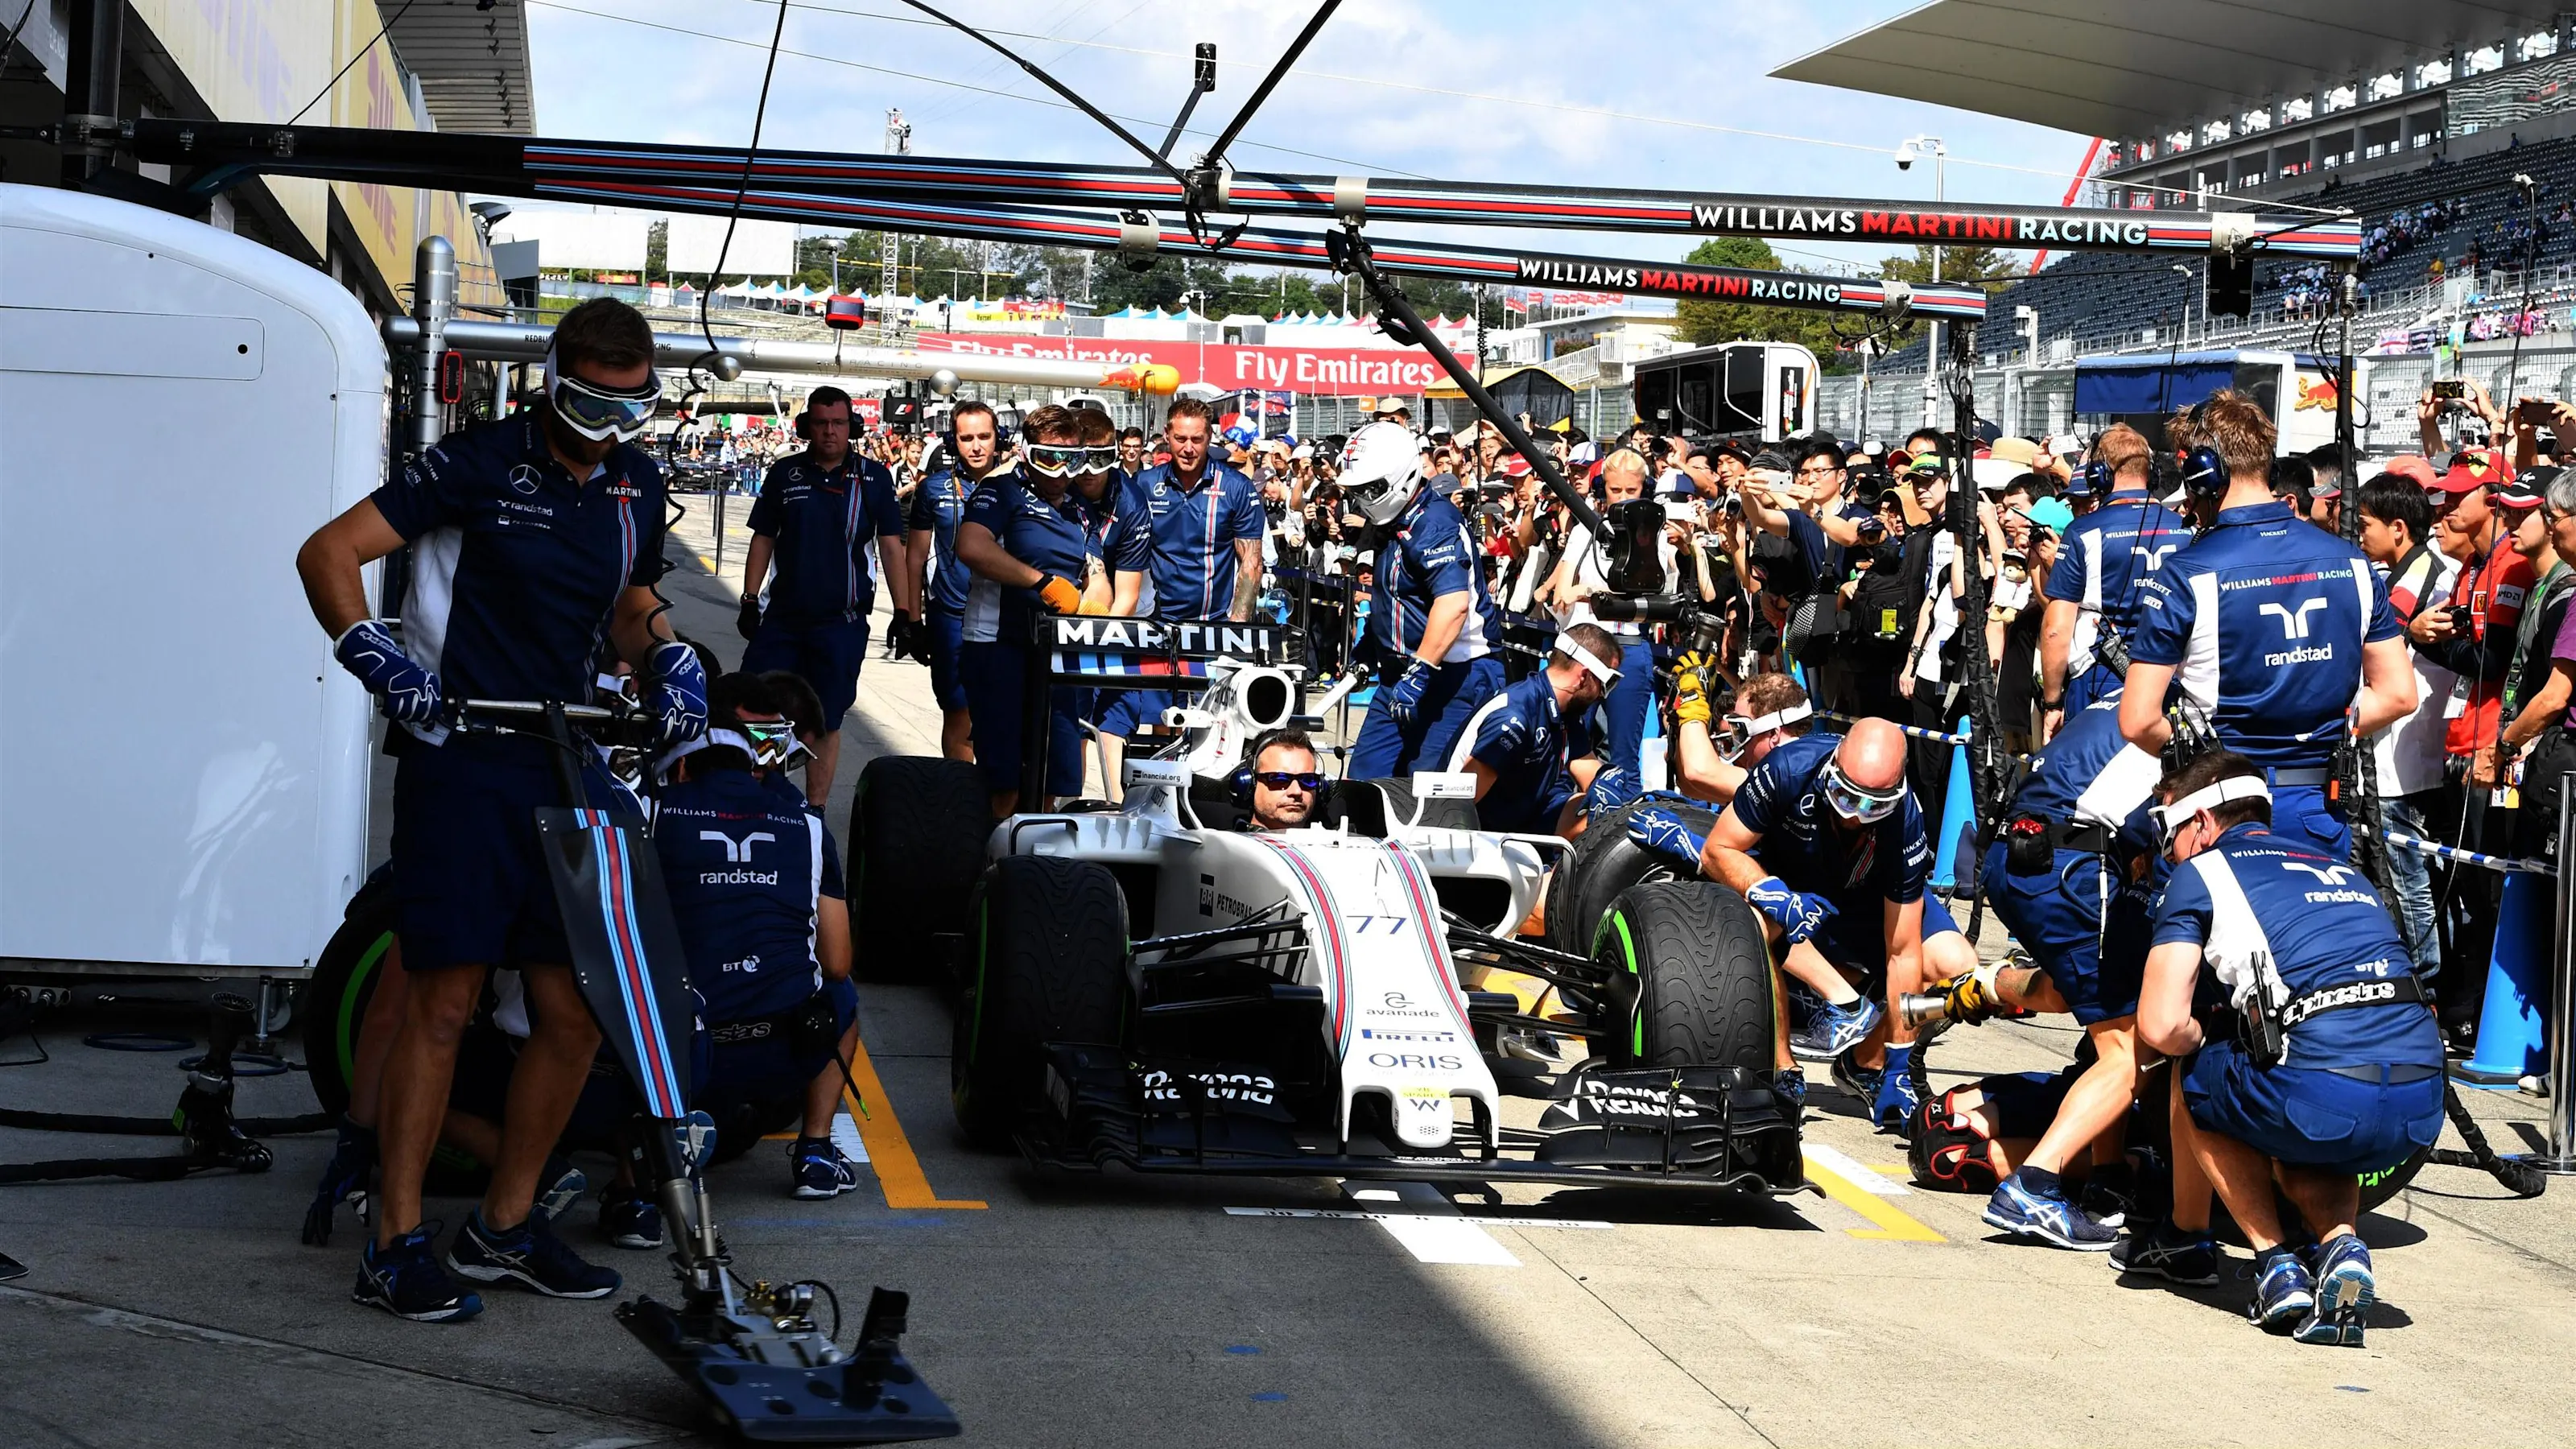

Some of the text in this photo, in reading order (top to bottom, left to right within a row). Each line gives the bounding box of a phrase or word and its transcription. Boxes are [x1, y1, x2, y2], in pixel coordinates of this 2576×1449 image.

[1694, 204, 2147, 245] WILLIAMS MARTINI RACING
[1518, 258, 1841, 303] WILLIAMS MARTINI RACING
[1235, 350, 1435, 387] Fly Emirates
[605, 486, 642, 497] MARTINI
[510, 502, 553, 517] randstad
[2220, 569, 2354, 592] WILLIAMS MARTINI RACING
[1057, 619, 1269, 654] MARTINI
[2264, 642, 2333, 667] randstad
[663, 807, 717, 819] WILLIAMS
[767, 814, 805, 827] RACING
[2231, 849, 2288, 859] WILLIAMS
[700, 869, 778, 886] randstad
[1216, 893, 1253, 919] PETROBRAS
[1347, 915, 1407, 935] 77
[722, 963, 741, 972] BT
[2281, 980, 2396, 1026] alpinestars
[1366, 1009, 1440, 1018] avanade
[1361, 1029, 1455, 1042] PIRELLI
[1368, 1053, 1463, 1070] ORIS
